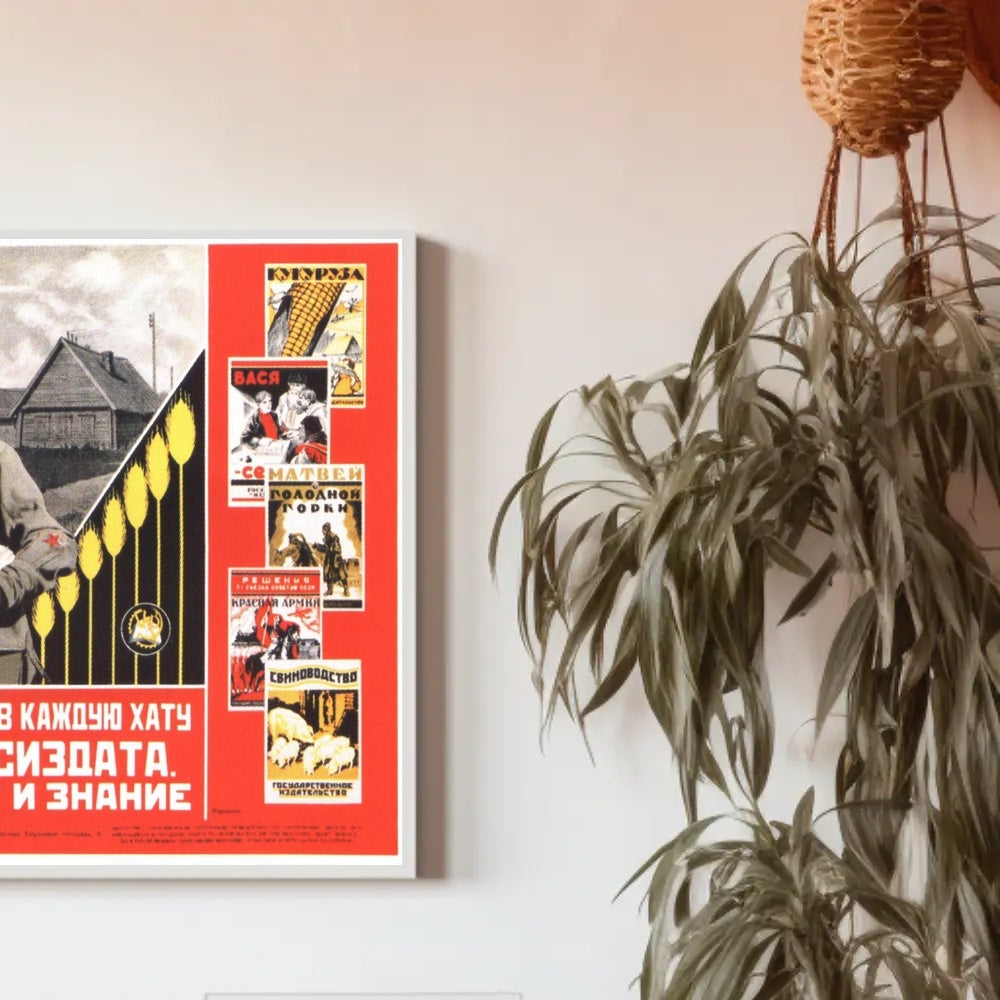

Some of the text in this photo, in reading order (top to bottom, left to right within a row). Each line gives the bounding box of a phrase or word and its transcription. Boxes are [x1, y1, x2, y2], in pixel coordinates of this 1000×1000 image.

[267, 267, 364, 282] КУКУРУЗА
[233, 370, 280, 386] ВАСЯ
[268, 467, 362, 481] МАТВЕЙ
[270, 488, 361, 500] ГОЛОДНОЙ
[270, 668, 358, 684] СВИНОВОДСТВО
[20, 702, 123, 731] КАЖДУЮ
[130, 702, 192, 731] ХАТУ
[13, 783, 35, 810] И
[46, 783, 191, 811] ЗНАНИЕ
